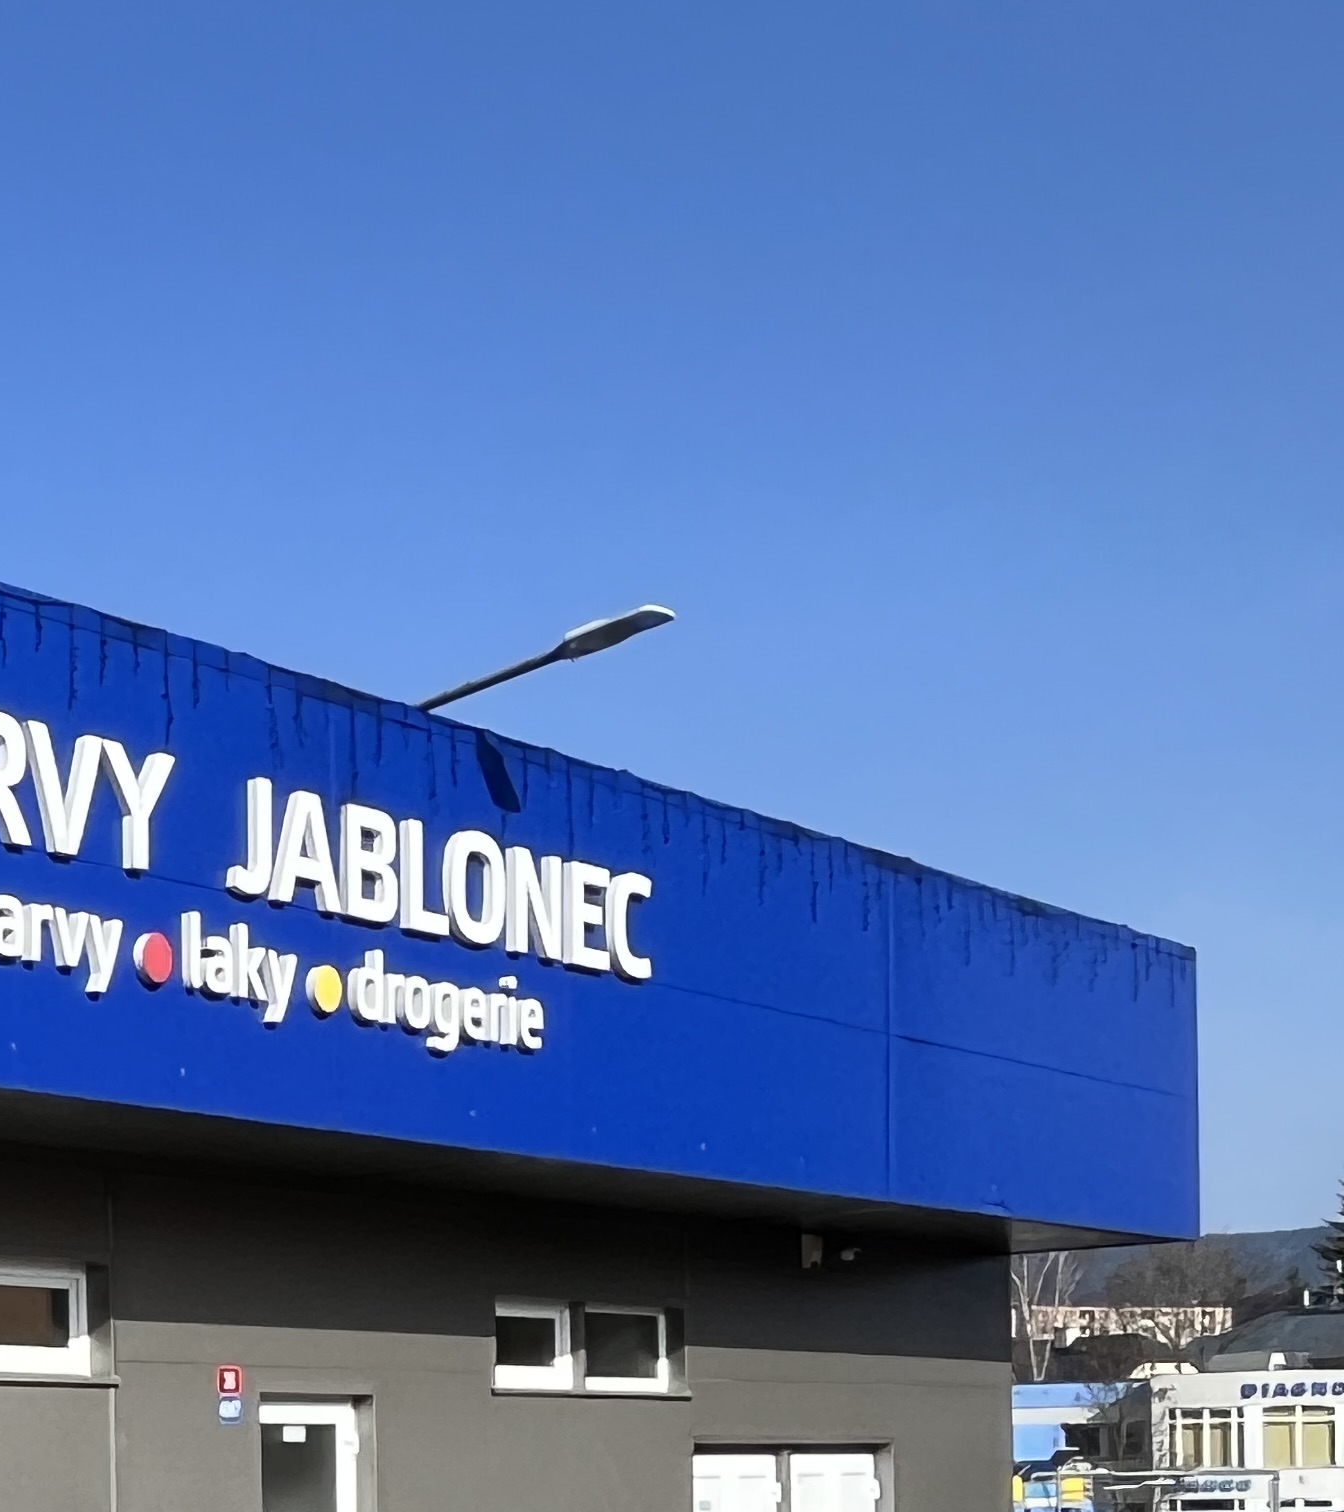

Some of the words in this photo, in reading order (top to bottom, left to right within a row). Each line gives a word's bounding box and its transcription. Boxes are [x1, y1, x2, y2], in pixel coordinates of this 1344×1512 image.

[225, 776, 653, 981] JABLONEC
[181, 910, 298, 1024] laky
[347, 948, 545, 1053] drogerie
